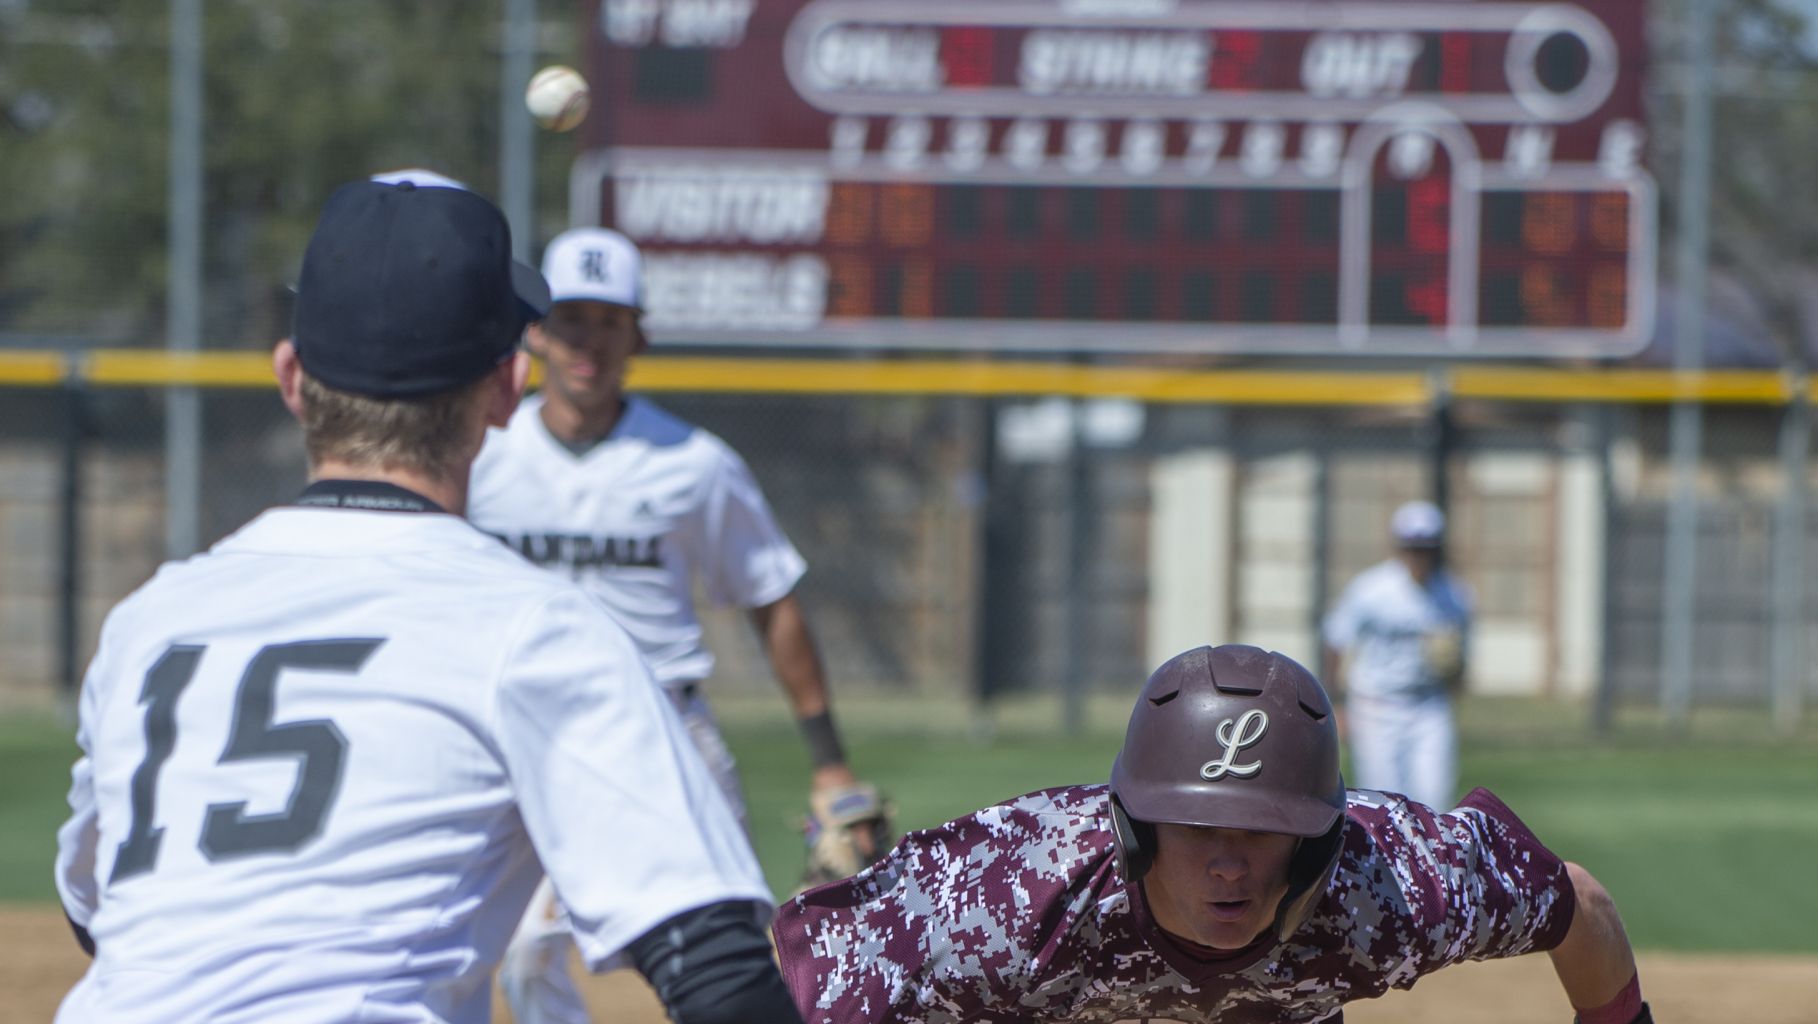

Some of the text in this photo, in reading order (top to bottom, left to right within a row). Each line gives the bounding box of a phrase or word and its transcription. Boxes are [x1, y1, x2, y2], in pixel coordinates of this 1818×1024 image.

[1021, 31, 1211, 94] STRIKE
[1304, 33, 1422, 97] OUT
[884, 117, 931, 171] 2
[945, 117, 989, 172] 3
[1184, 120, 1226, 175] 7
[615, 166, 828, 243] VISITOR
[640, 252, 828, 330] EBELS
[107, 636, 390, 886] 15
[1200, 709, 1269, 781] L
